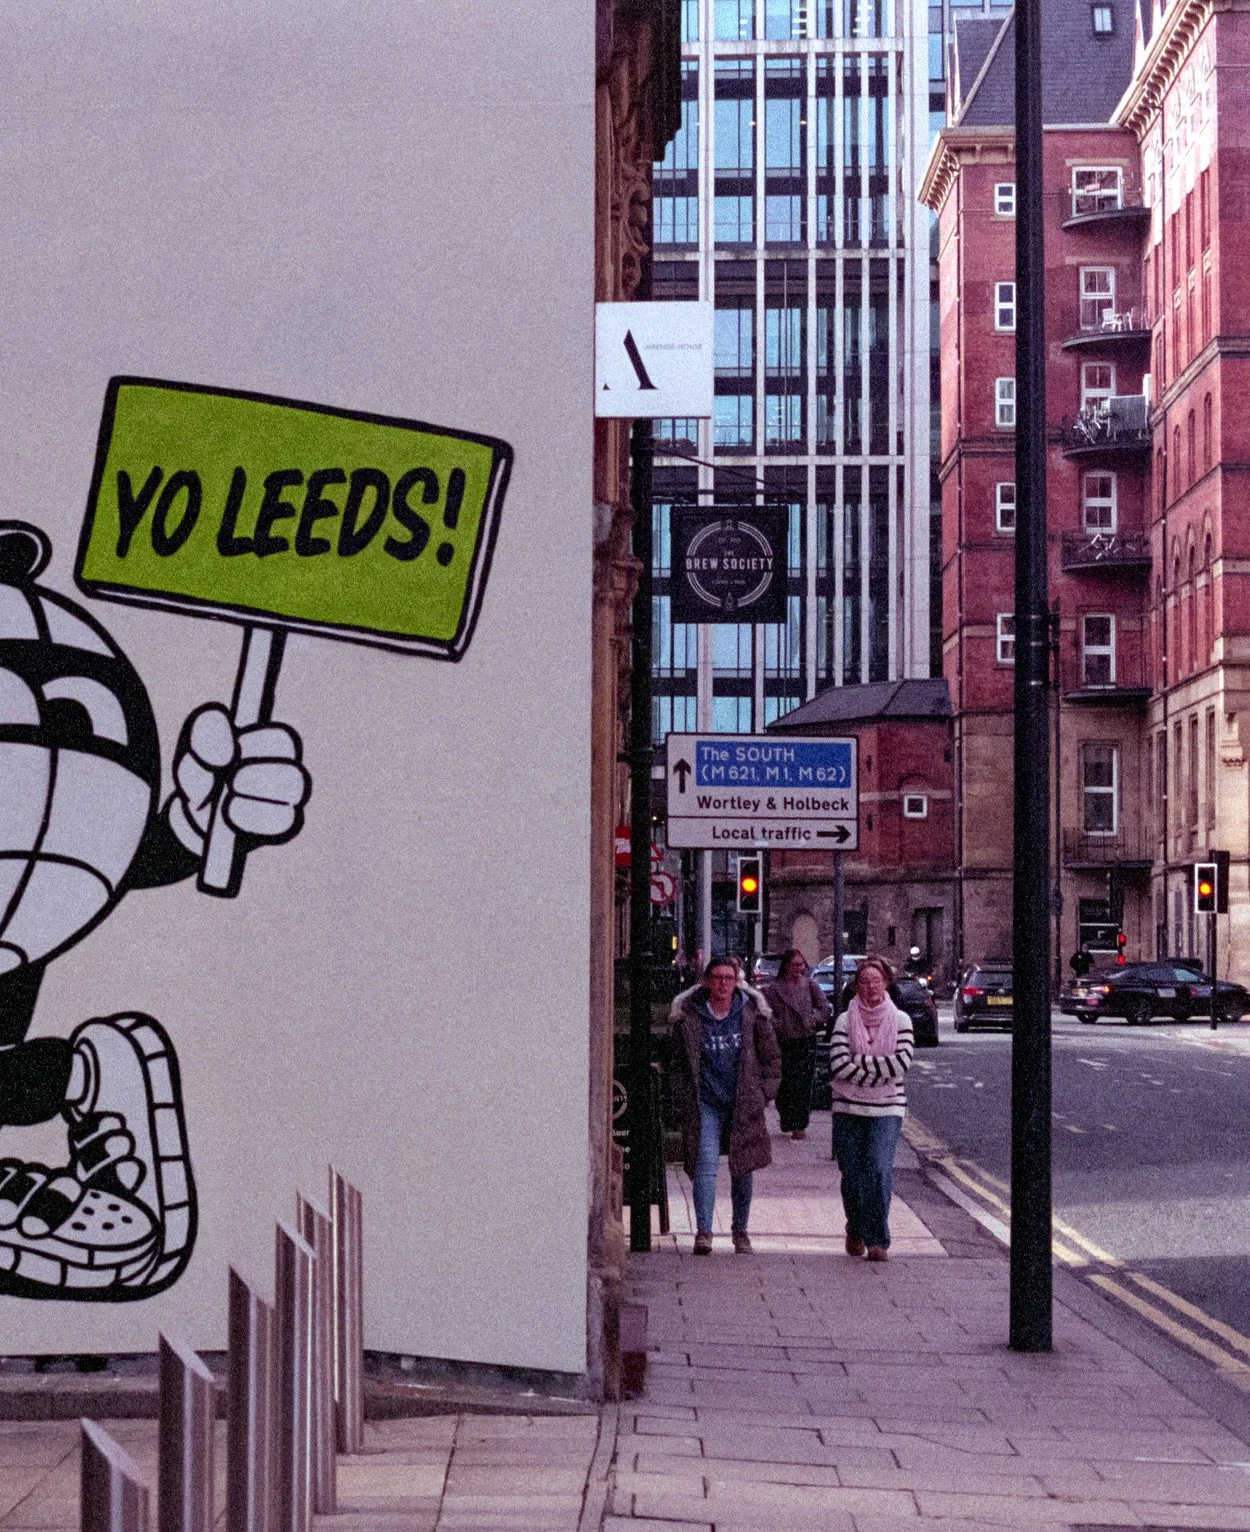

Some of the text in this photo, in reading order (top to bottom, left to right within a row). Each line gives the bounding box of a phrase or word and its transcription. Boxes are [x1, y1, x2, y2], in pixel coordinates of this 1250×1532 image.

[115, 465, 466, 566] YO LEEDS!
[686, 558, 773, 570] BREW SOCIETY
[701, 747, 795, 762] The SOUTH
[696, 795, 849, 812] Wortley & Holbeck
[712, 826, 811, 841] Local traffic
